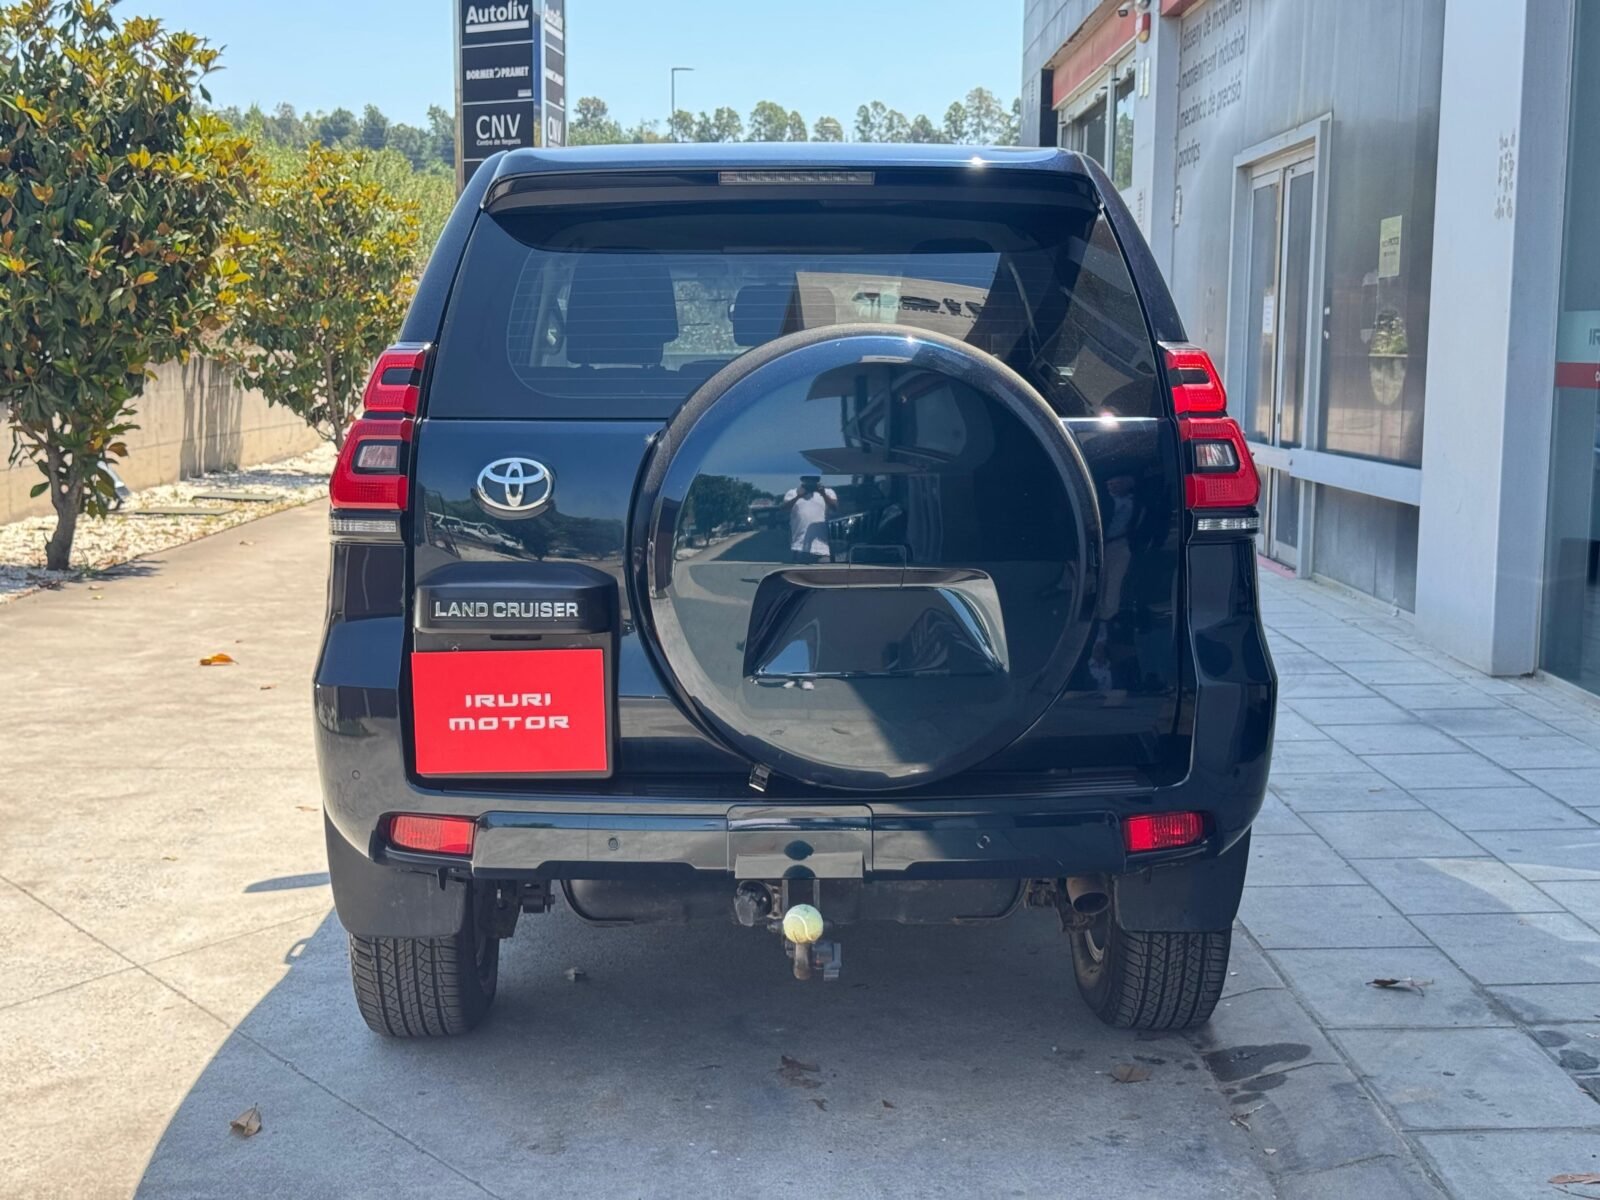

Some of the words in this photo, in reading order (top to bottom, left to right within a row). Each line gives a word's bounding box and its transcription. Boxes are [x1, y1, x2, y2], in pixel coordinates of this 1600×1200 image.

[466, 1, 529, 23] Autoliv
[476, 114, 521, 139] CNV
[435, 602, 488, 617] LAND
[493, 602, 579, 617] CRUISER
[465, 693, 551, 708] IRURI
